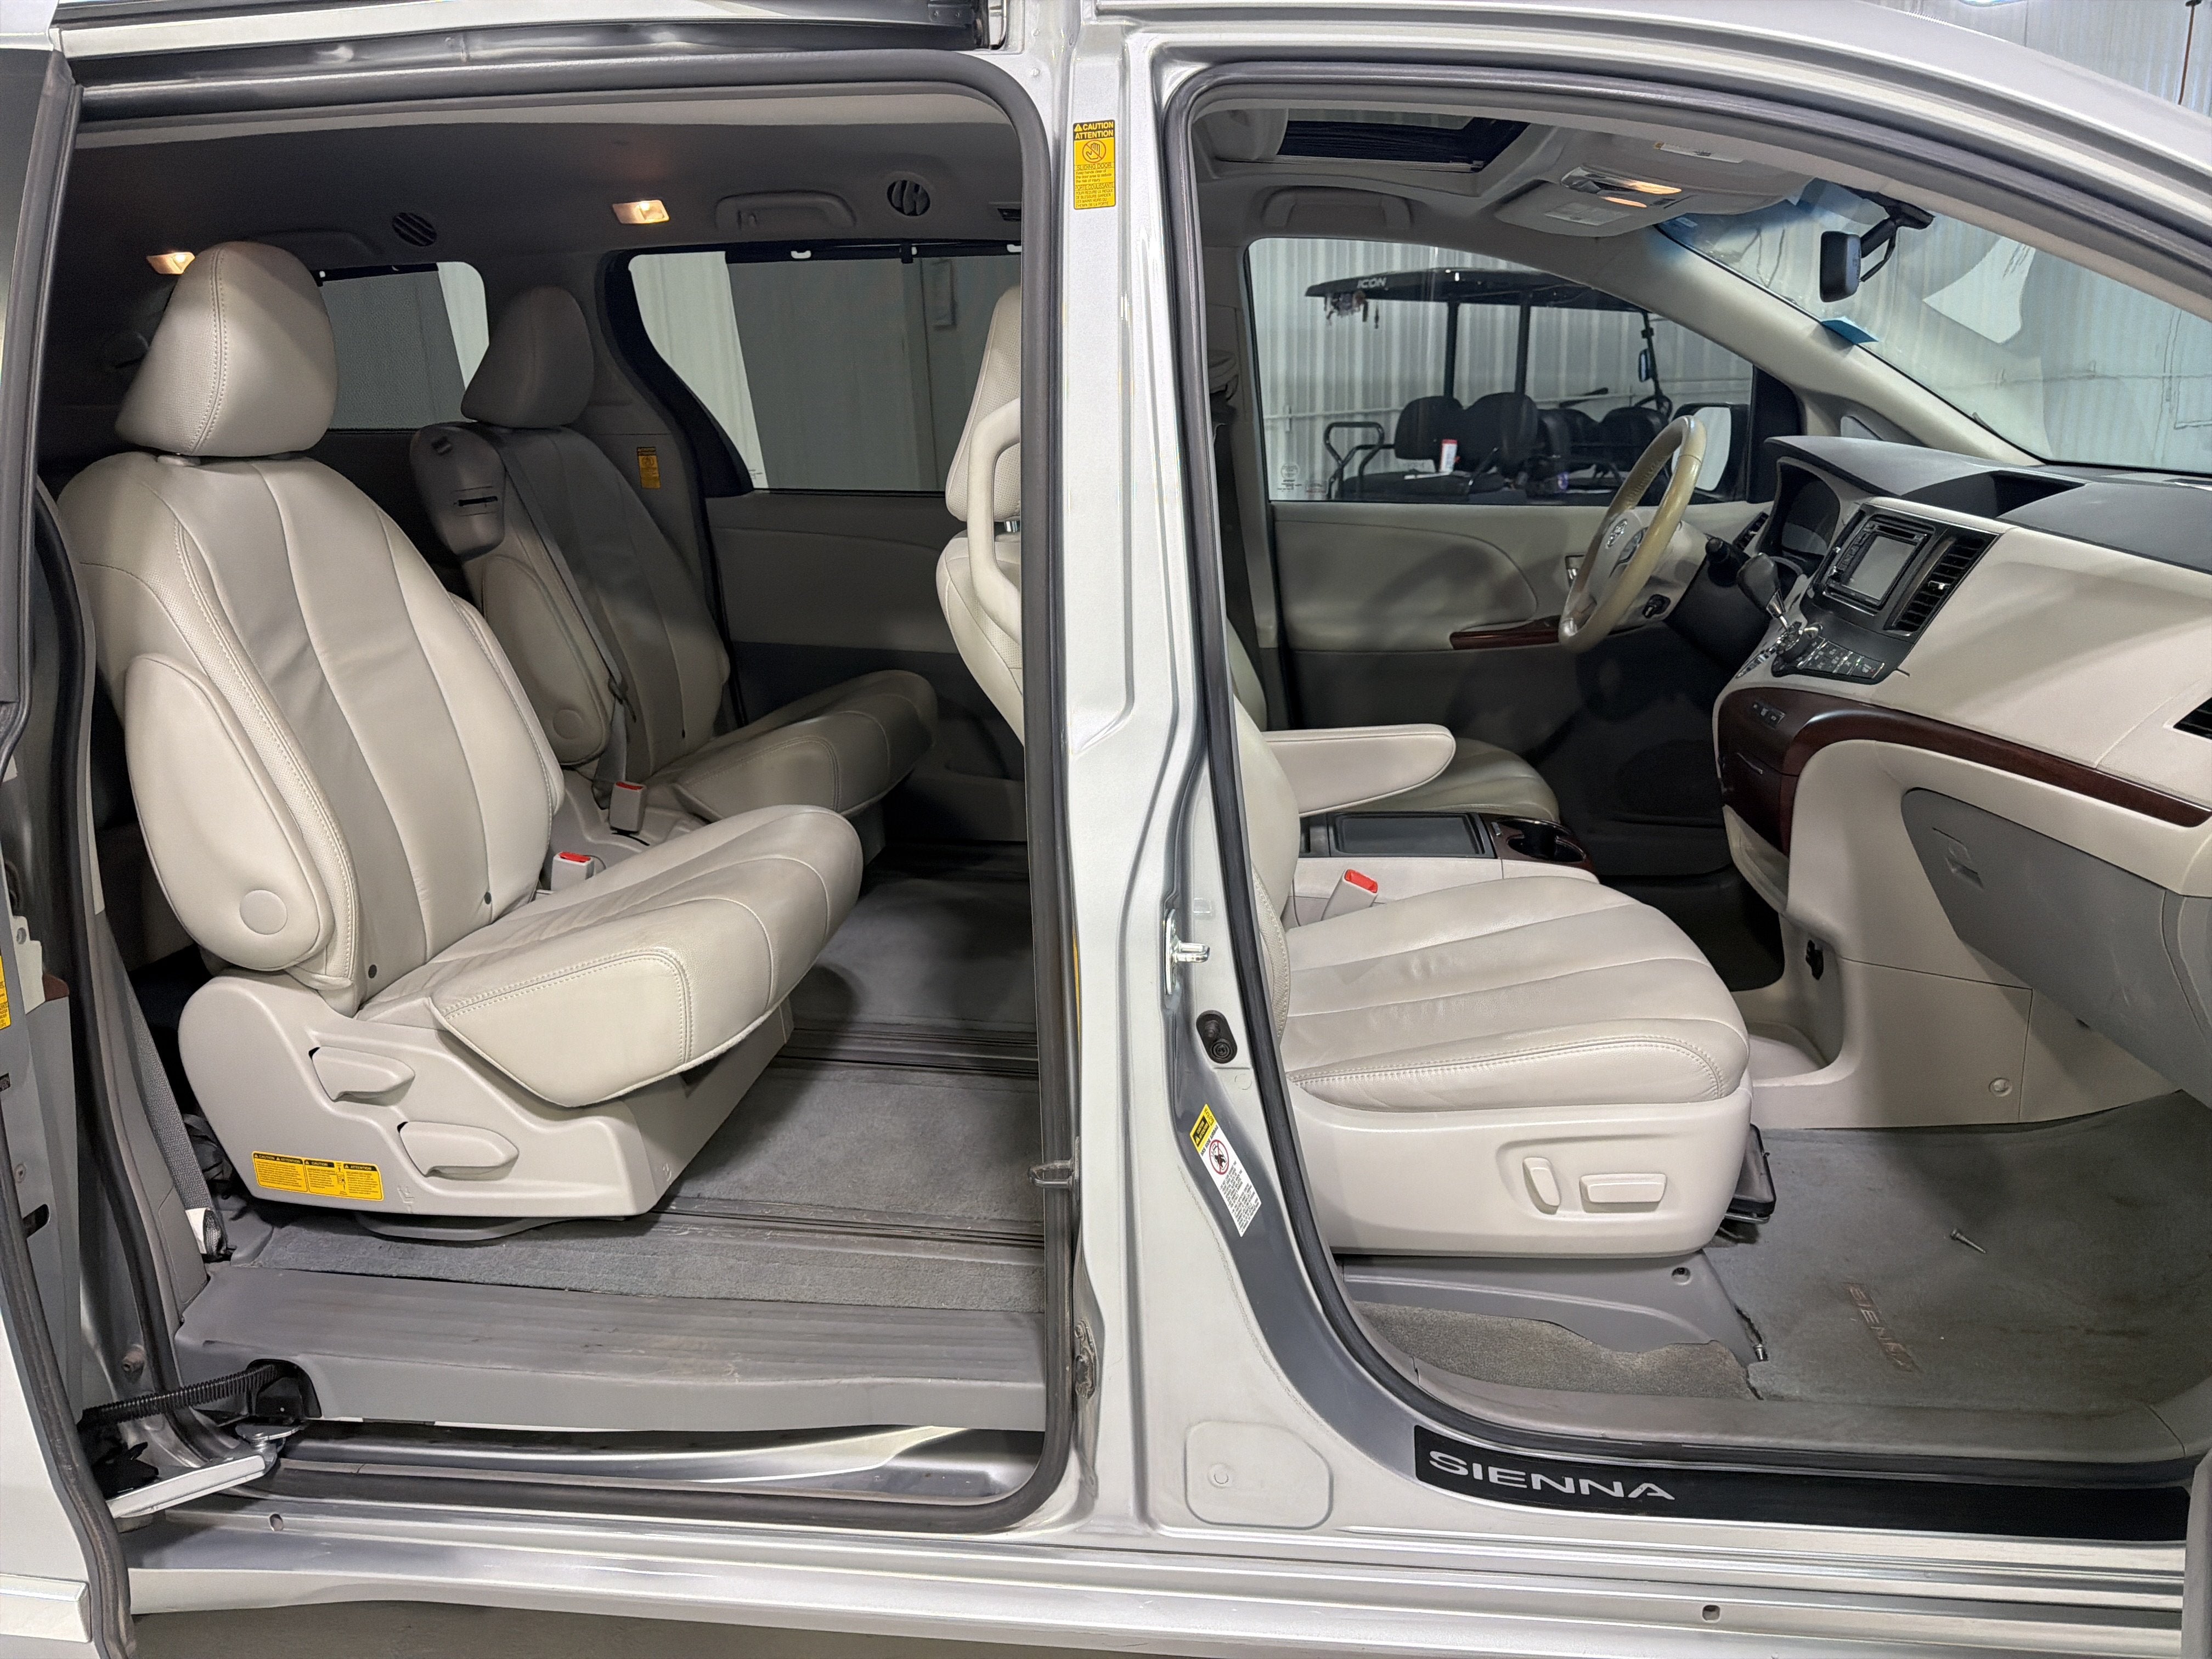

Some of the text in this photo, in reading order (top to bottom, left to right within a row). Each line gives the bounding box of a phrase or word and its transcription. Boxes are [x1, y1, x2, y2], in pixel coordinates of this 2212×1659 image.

[1082, 121, 1114, 131] CAUTION
[1075, 129, 1114, 140] ATTENTION
[1357, 277, 1387, 289] ICON
[1429, 1450, 1675, 1500] SIENNA
